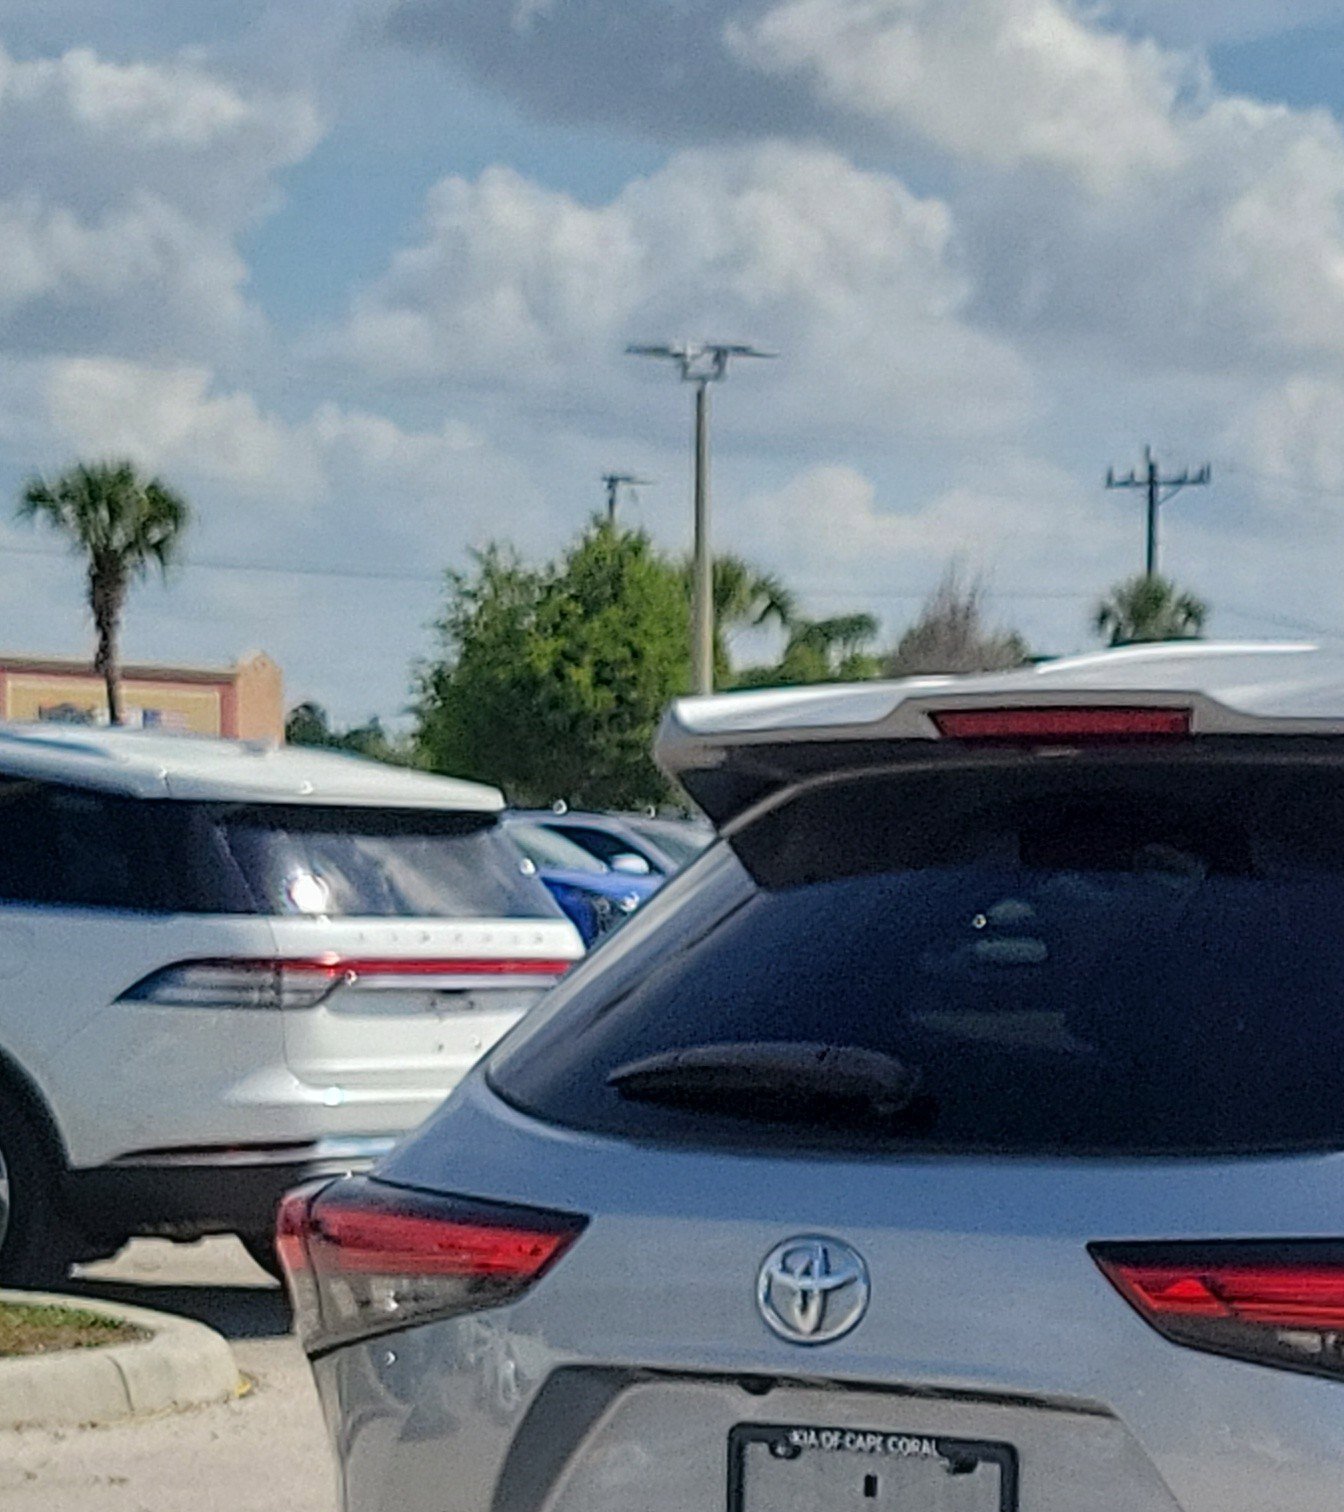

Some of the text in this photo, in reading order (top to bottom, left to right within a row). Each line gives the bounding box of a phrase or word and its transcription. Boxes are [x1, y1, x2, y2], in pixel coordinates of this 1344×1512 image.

[788, 1429, 939, 1456] KIA OF CAPE CORAL
